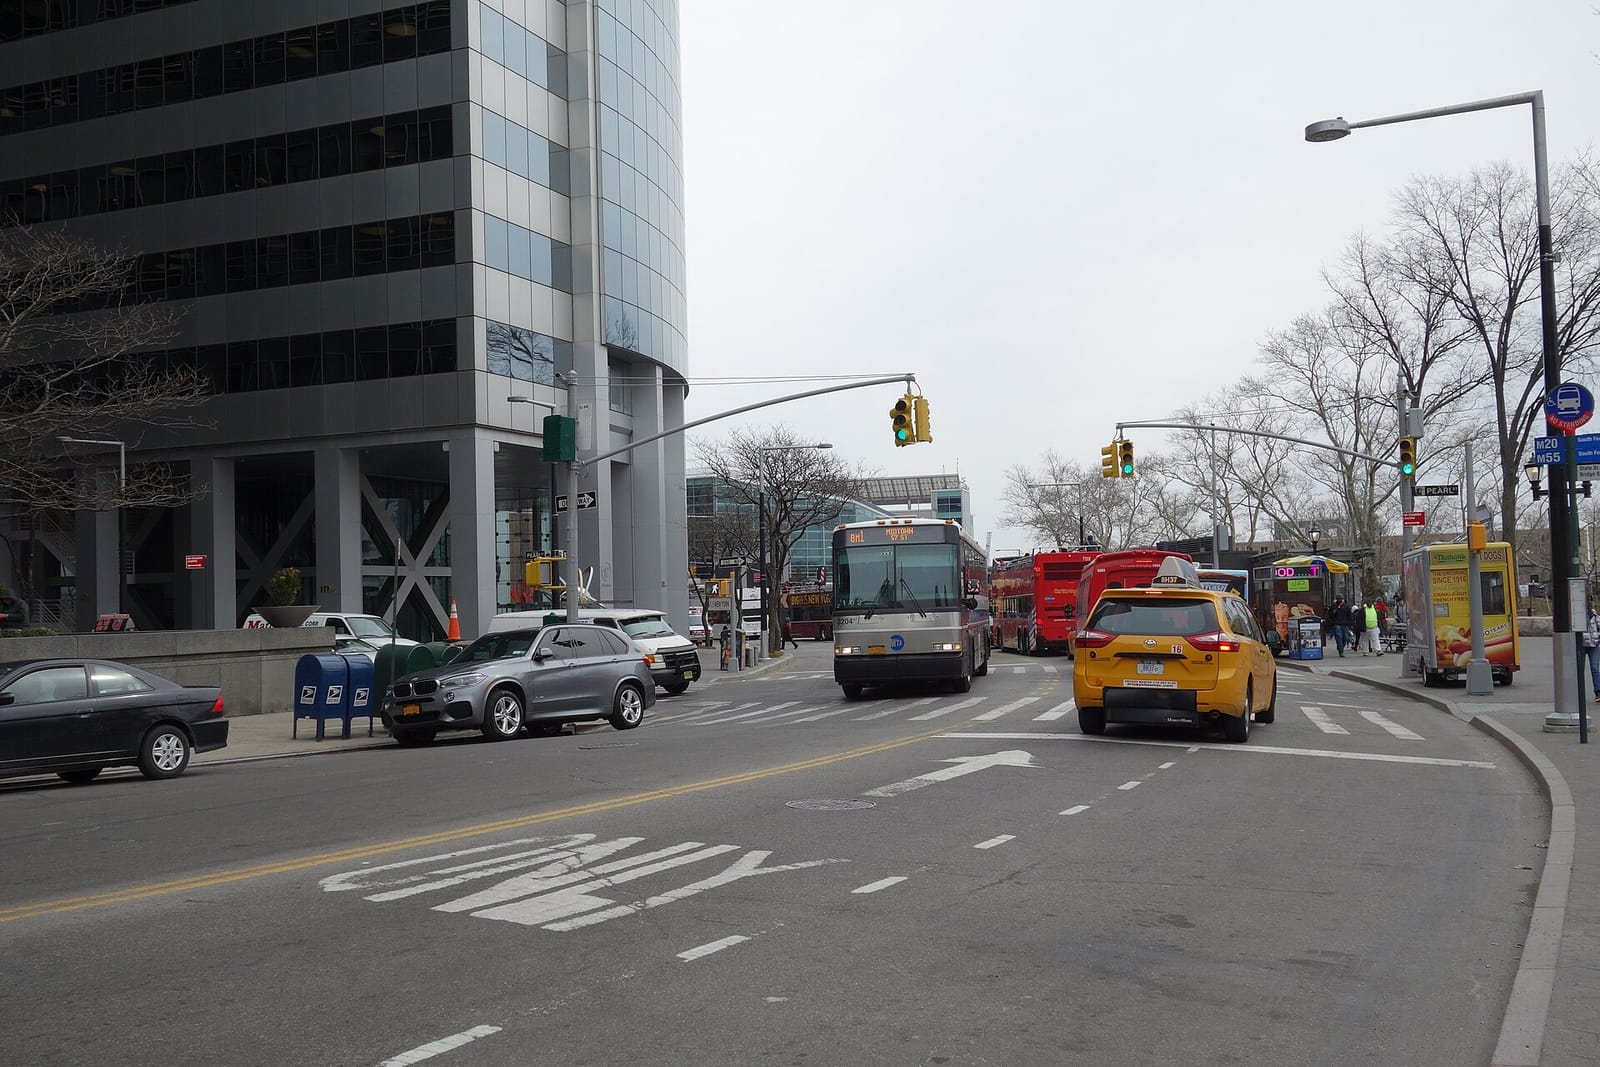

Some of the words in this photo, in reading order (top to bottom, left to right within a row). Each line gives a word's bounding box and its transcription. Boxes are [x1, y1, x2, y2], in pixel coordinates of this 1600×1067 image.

[1560, 414, 1590, 429] STANDING
[1536, 438, 1558, 449] M20
[1537, 452, 1561, 463] M55
[1426, 486, 1453, 495] PEARL
[850, 528, 865, 543] BM1
[885, 527, 914, 536] MIDTOWN
[1483, 551, 1502, 560] DOGS
[1432, 577, 1452, 585] SINCE
[1172, 645, 1182, 654] 16
[318, 833, 851, 932] ONLY
